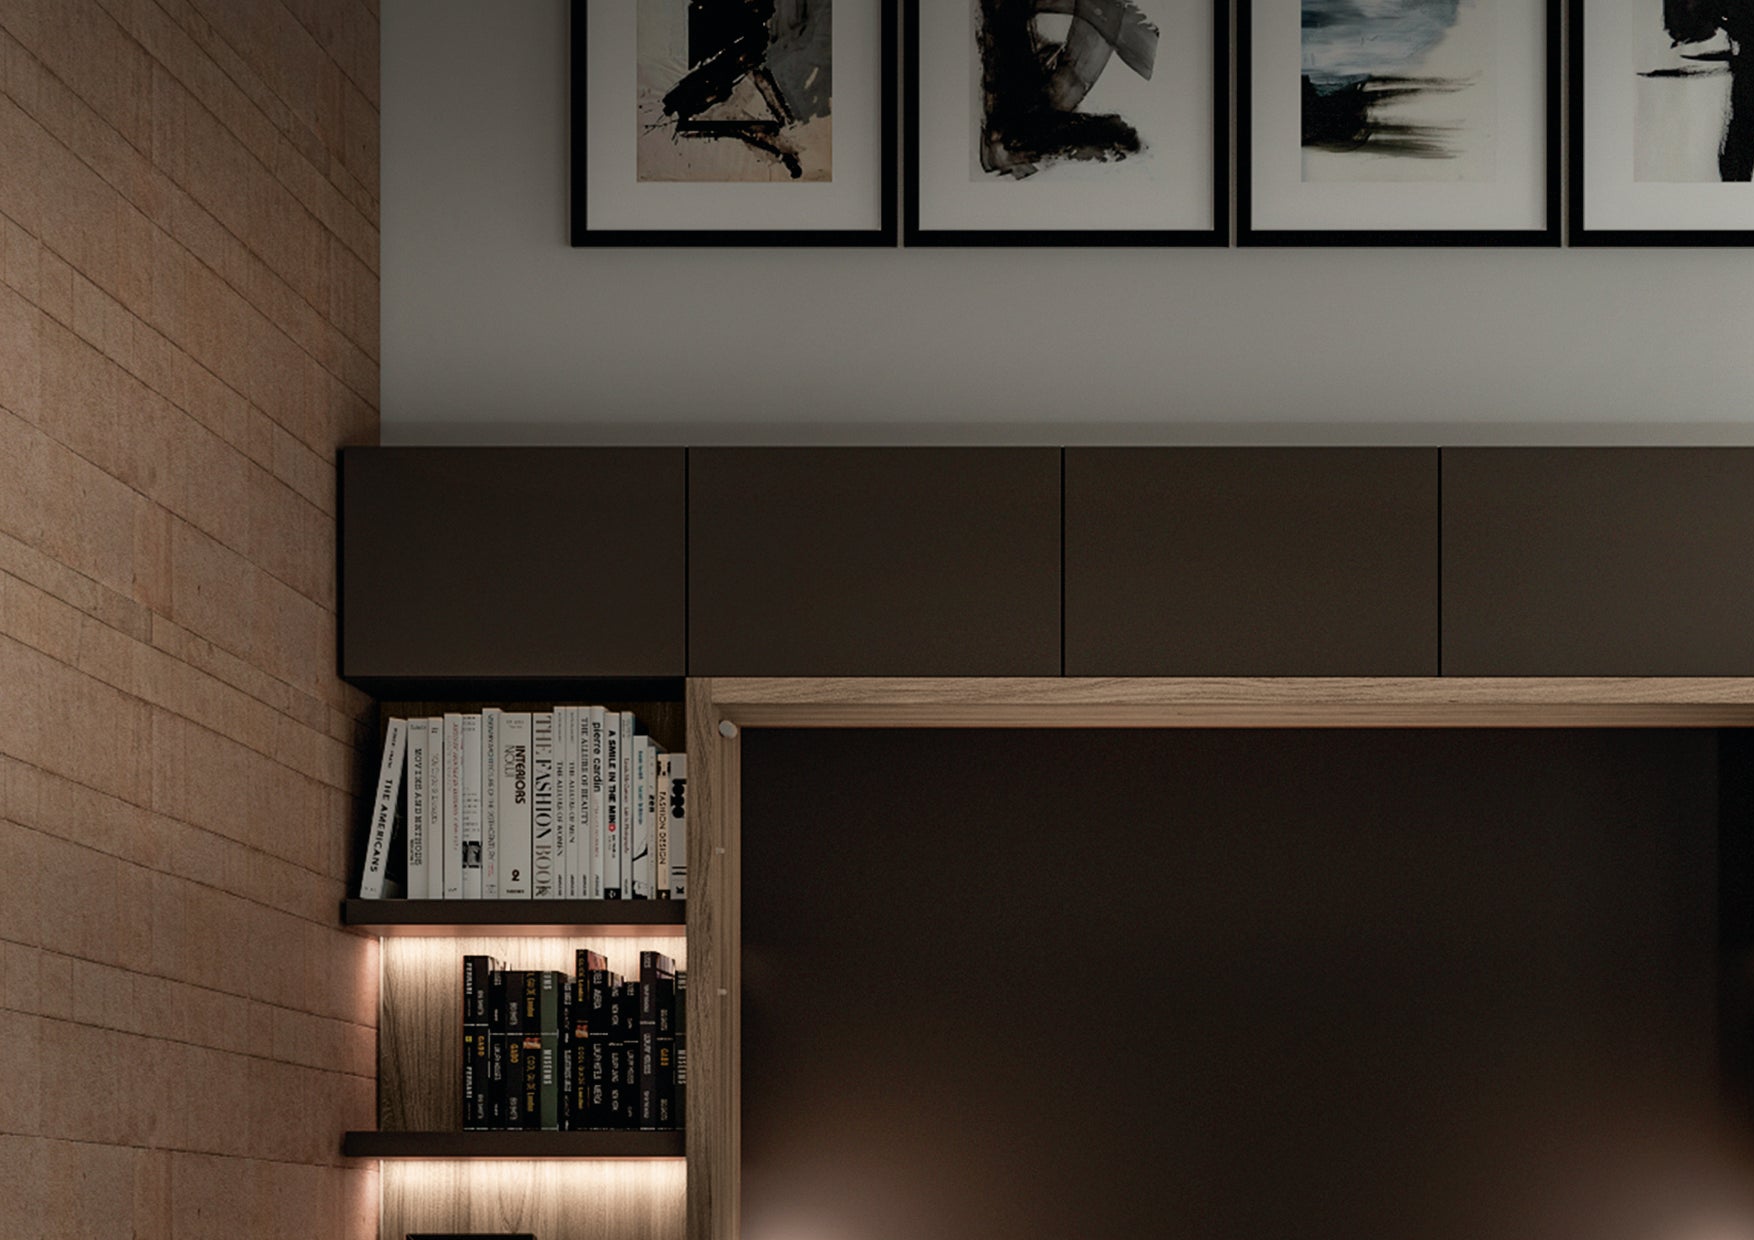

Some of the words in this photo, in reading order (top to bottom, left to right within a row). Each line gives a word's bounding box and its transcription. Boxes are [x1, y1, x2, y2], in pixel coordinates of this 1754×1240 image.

[534, 715, 552, 755] THE
[580, 717, 589, 736] THE
[592, 722, 602, 754] pierre
[608, 729, 616, 737] A
[608, 740, 616, 769] SMILE
[383, 778, 393, 801] THE
[515, 745, 526, 804] INTERIORS
[592, 758, 602, 792] cardin
[608, 771, 616, 782] IN
[534, 759, 552, 839] FASHION
[580, 789, 589, 825] BEAUTY
[608, 785, 616, 802] THE
[370, 804, 388, 873] AMERICANS
[512, 869, 521, 881] 2
[534, 845, 552, 897] BOOK
